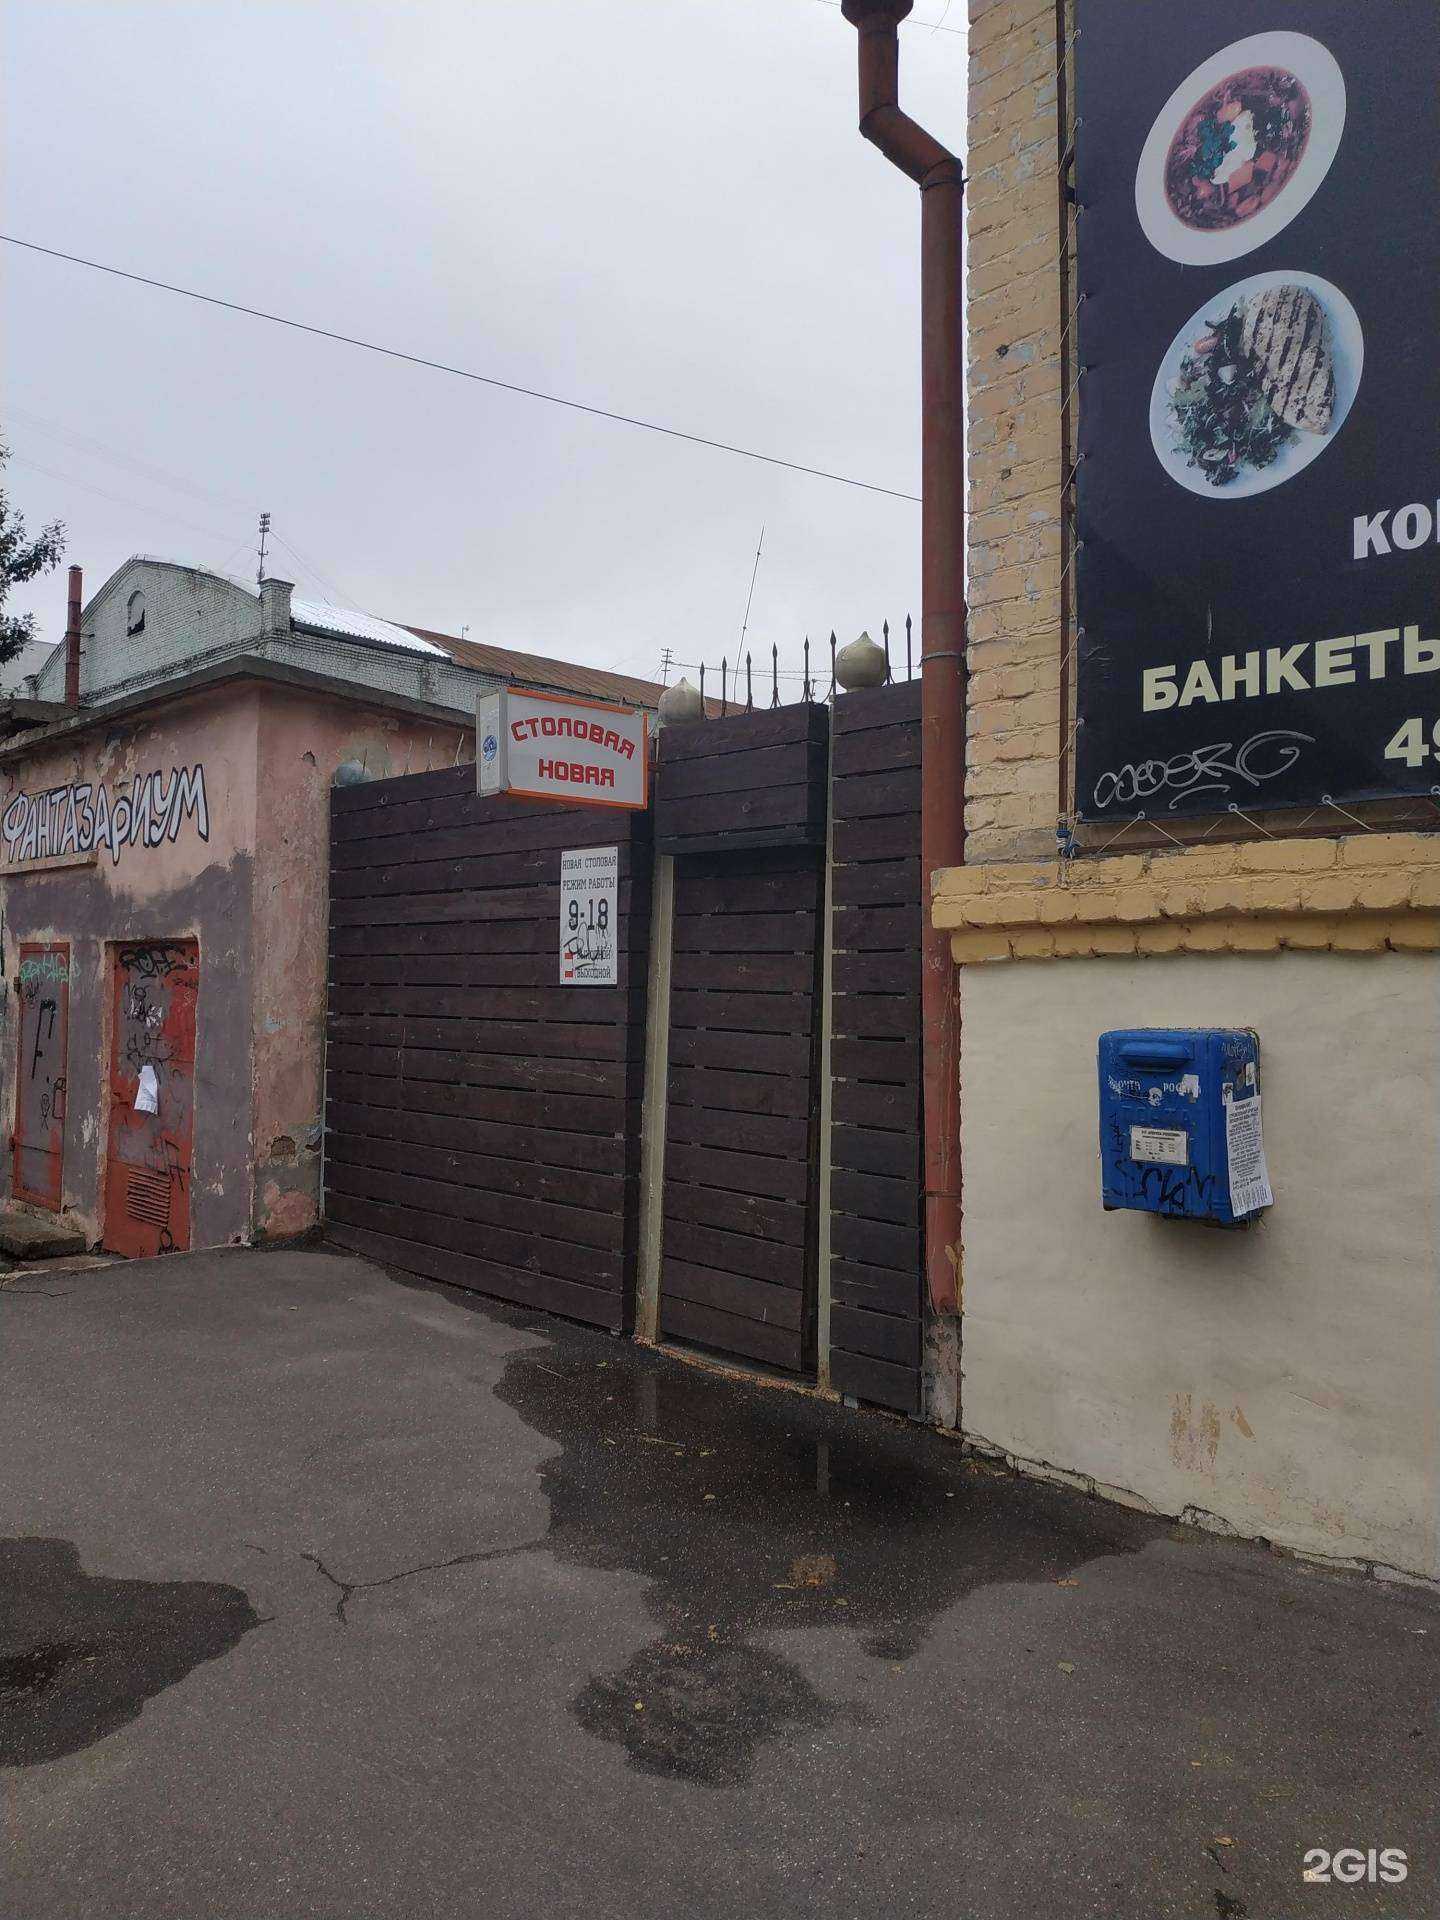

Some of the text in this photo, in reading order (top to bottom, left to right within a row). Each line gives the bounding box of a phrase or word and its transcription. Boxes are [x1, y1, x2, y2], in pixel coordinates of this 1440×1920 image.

[1353, 498, 1440, 560] КО
[511, 717, 635, 760] СТОЛОВАЯ
[1384, 717, 1440, 767] 4
[538, 759, 615, 788] НОВАЯ
[562, 855, 617, 871] НОВАЯ СТОЛОВАЯ
[562, 876, 616, 891] РЕЖИМ РАБОТЫ
[568, 898, 609, 931] 9-18
